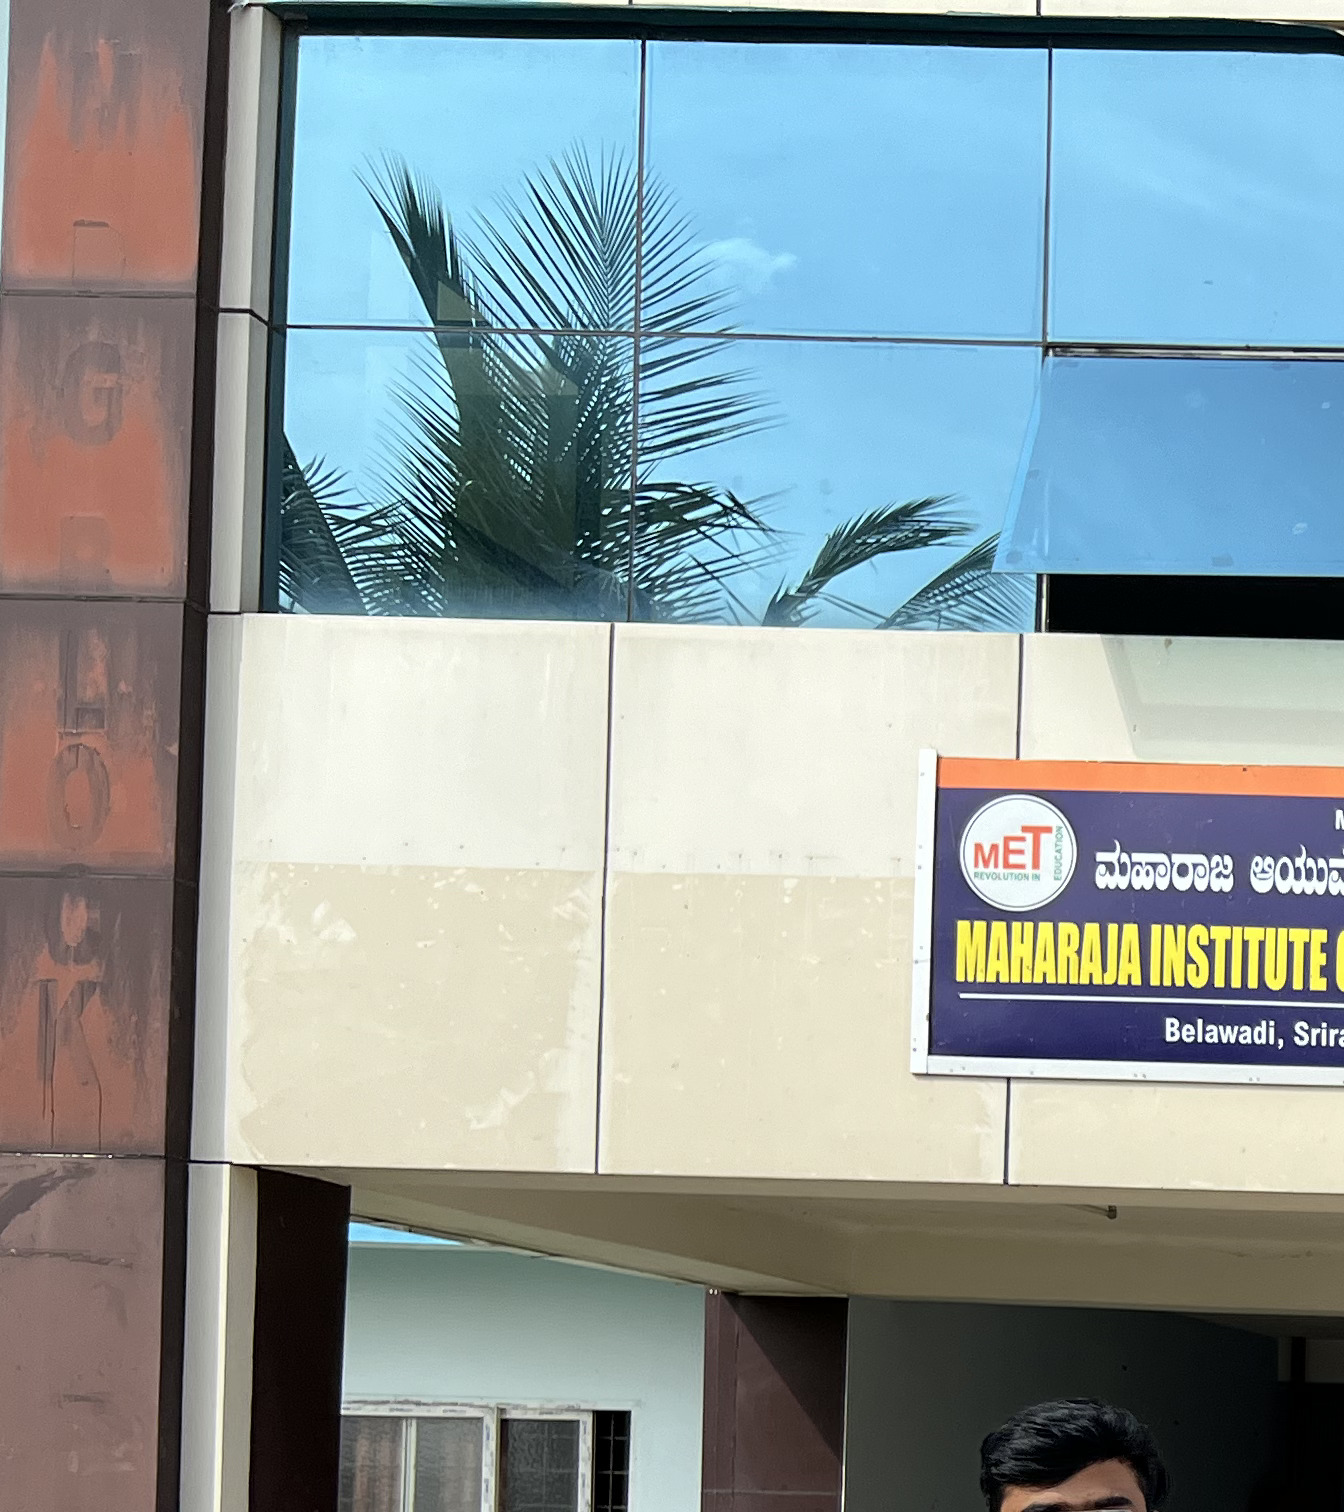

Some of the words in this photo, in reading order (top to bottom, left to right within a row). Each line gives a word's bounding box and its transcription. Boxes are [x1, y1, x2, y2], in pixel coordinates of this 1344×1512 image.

[974, 826, 1053, 870] MET
[1054, 826, 1064, 880] EDUCATION
[1095, 839, 1233, 892] ಮಹಾರಾಜ
[974, 871, 1029, 881] REVOLUTION
[1032, 873, 1040, 881] IN
[956, 920, 1141, 984] MAHARAJA
[1150, 924, 1327, 990] INSTITUTE
[1166, 1018, 1283, 1049] Belawadi,
